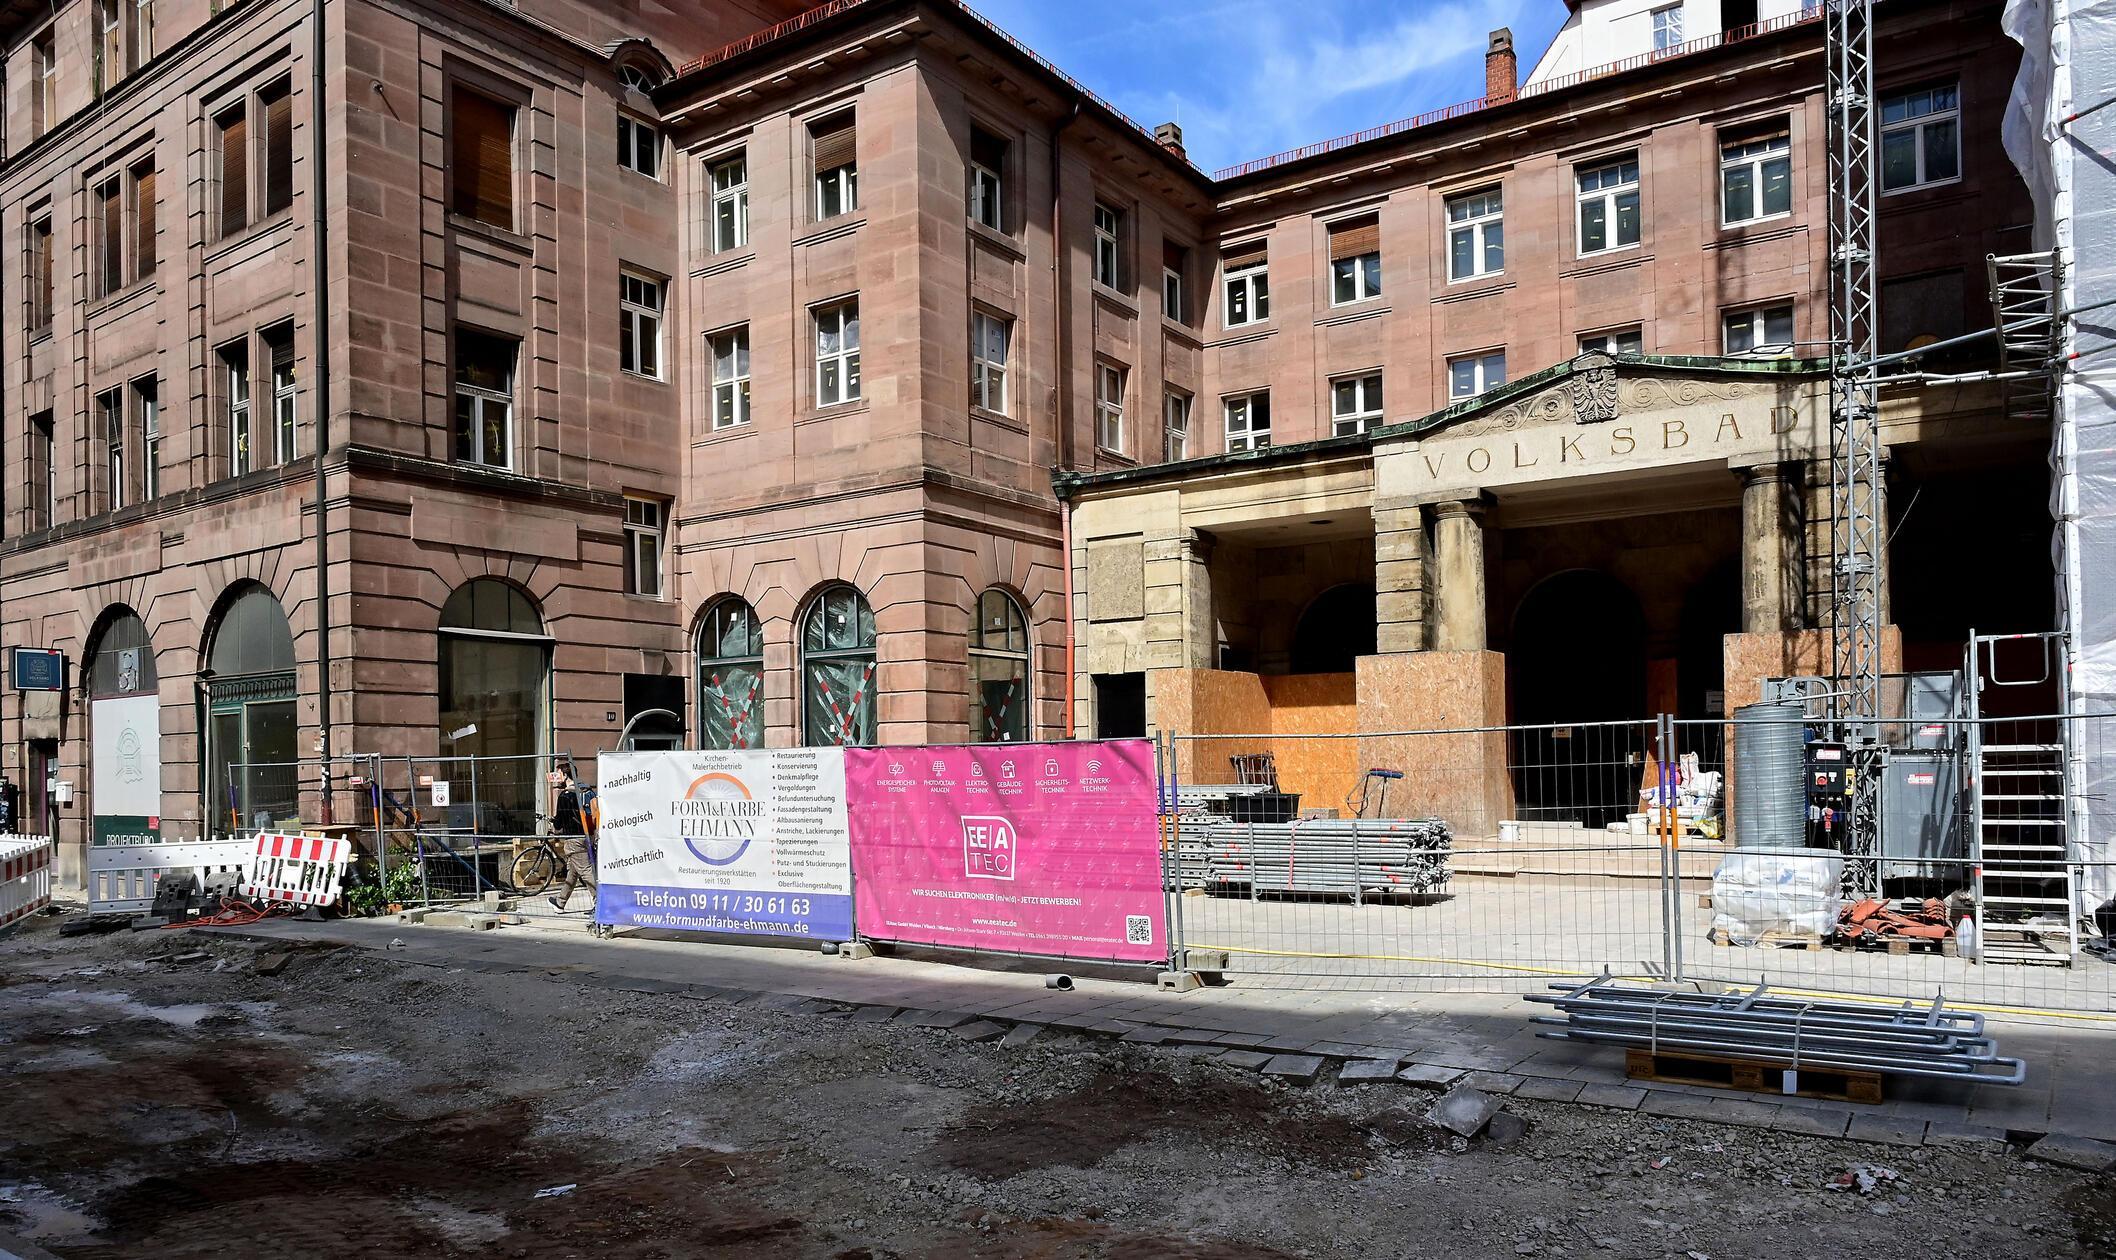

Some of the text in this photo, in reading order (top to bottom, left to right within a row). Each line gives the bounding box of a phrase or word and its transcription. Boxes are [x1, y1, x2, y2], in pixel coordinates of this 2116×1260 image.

[1422, 406, 1799, 479] VOLKSBAD
[608, 770, 651, 788] nachhaltig
[671, 801, 766, 816] FORM&FARBE
[777, 806, 832, 814] Fassadengestaltung
[608, 810, 653, 830] ökologisch
[680, 818, 756, 837] EHMANN
[806, 828, 844, 836] Lackierungen
[608, 848, 664, 870] wirtschaftlich
[970, 853, 1008, 872] TEC
[678, 867, 756, 878] Restaurierungswerkstätten
[778, 881, 842, 891] Oberflächengestaltung
[634, 890, 810, 915] Telefon 09 11 / 30 61 63
[925, 889, 947, 898] SUCHEN
[948, 891, 994, 901] ELEKTRONIKER
[1020, 896, 1039, 904] JETZT
[1040, 896, 1082, 906] BEWERBEN!
[633, 912, 809, 934] www.formundfarbe-ehmann.de
[972, 918, 1018, 927] www.eeatec.de
